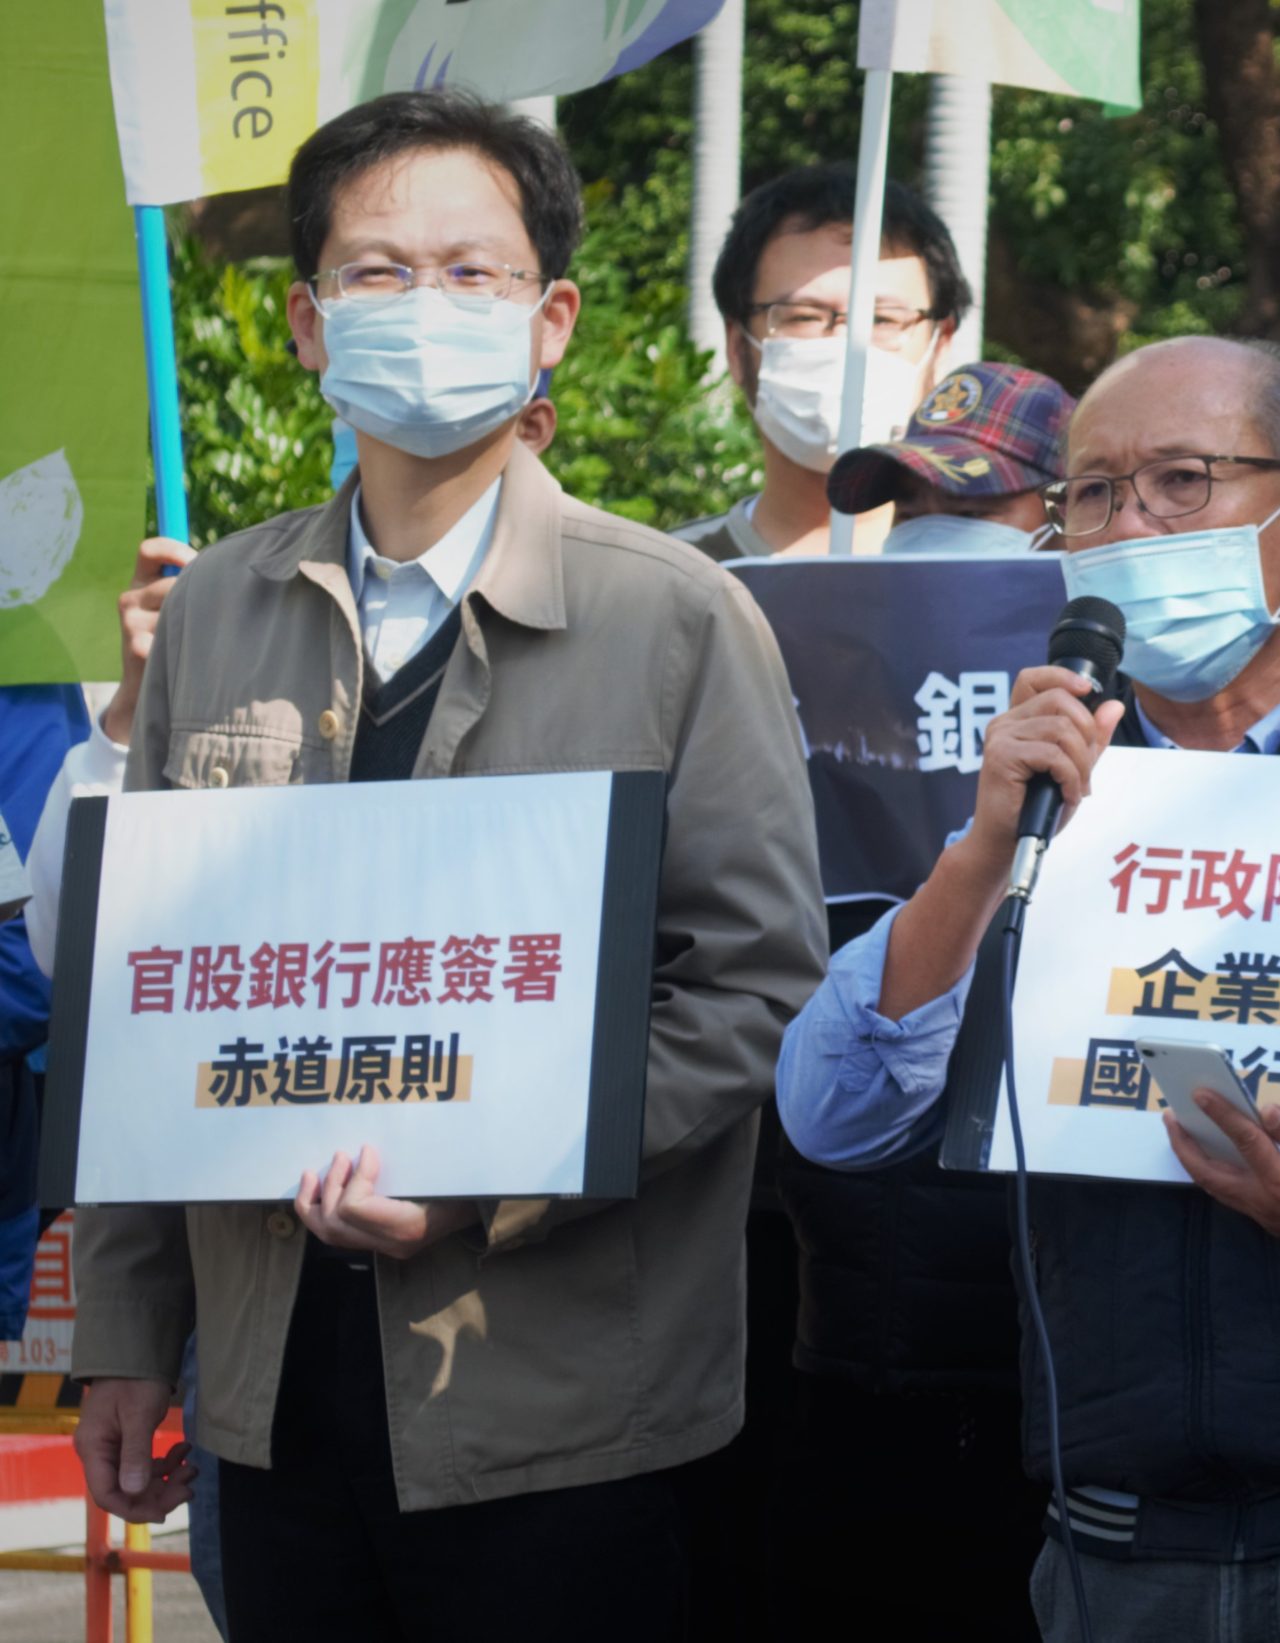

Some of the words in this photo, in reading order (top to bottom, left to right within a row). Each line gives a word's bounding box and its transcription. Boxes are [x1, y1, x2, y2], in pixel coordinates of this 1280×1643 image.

[126, 933, 563, 1015] 官股銀行應簽署
[208, 1032, 462, 1107] 赤道原則
